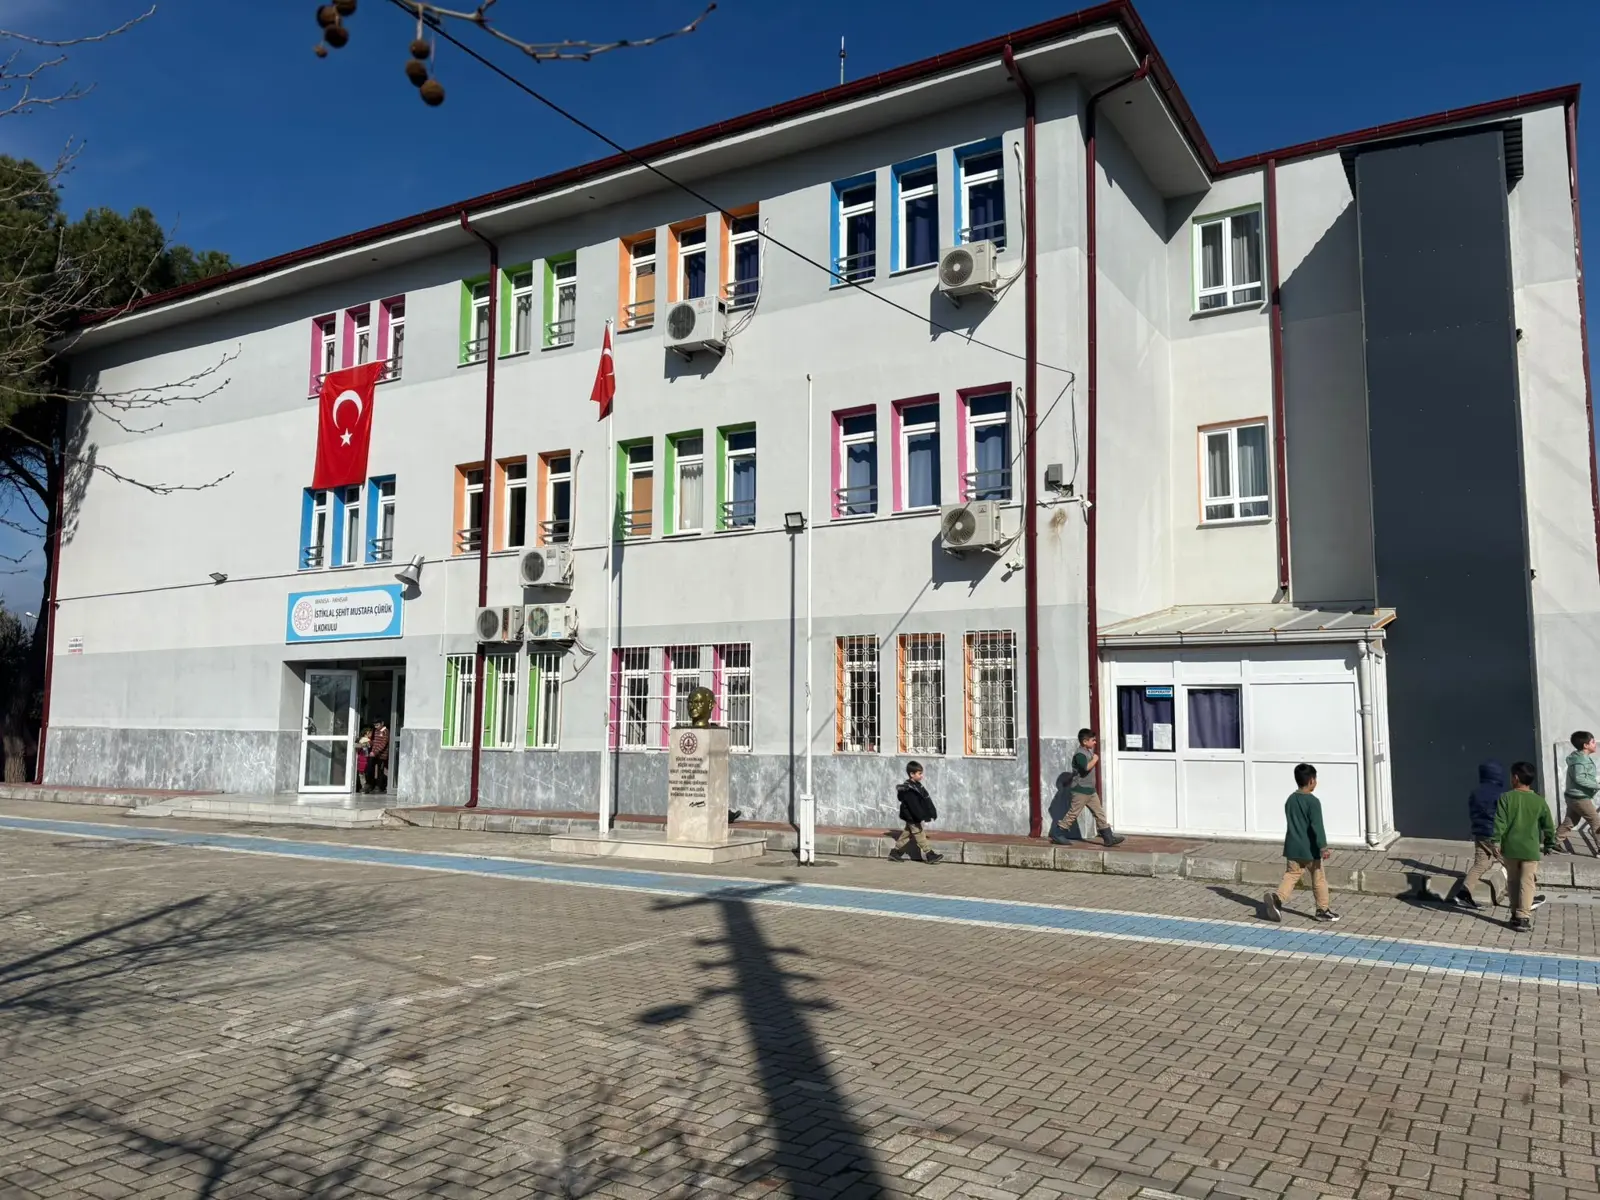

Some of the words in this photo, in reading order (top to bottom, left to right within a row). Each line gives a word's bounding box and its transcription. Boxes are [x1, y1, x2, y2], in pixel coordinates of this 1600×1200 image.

[314, 608, 334, 618] İSTİKLAL
[336, 606, 350, 619] ŞEHİT
[350, 605, 373, 616] MUSTAFA
[374, 604, 392, 616] ÇÜRÜK
[313, 623, 338, 632] İLKOKULU
